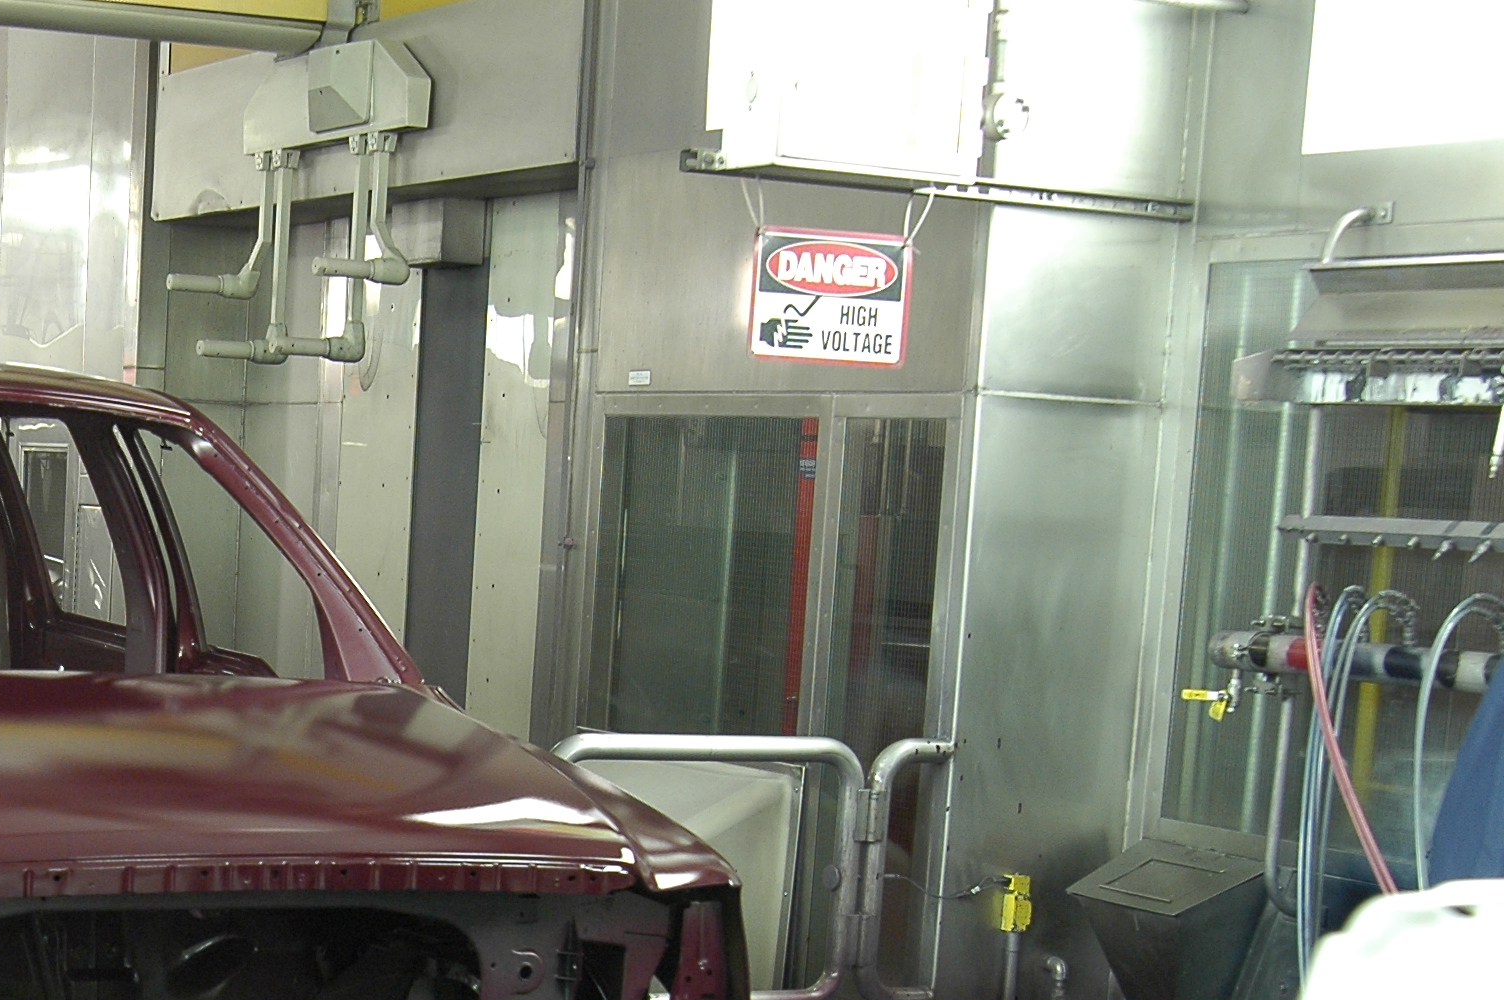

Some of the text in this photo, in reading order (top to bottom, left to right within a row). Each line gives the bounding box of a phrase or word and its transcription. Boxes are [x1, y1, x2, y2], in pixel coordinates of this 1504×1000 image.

[777, 250, 887, 287] DANGER
[839, 305, 878, 327] HIGH
[821, 330, 893, 355] VOLTAGE
